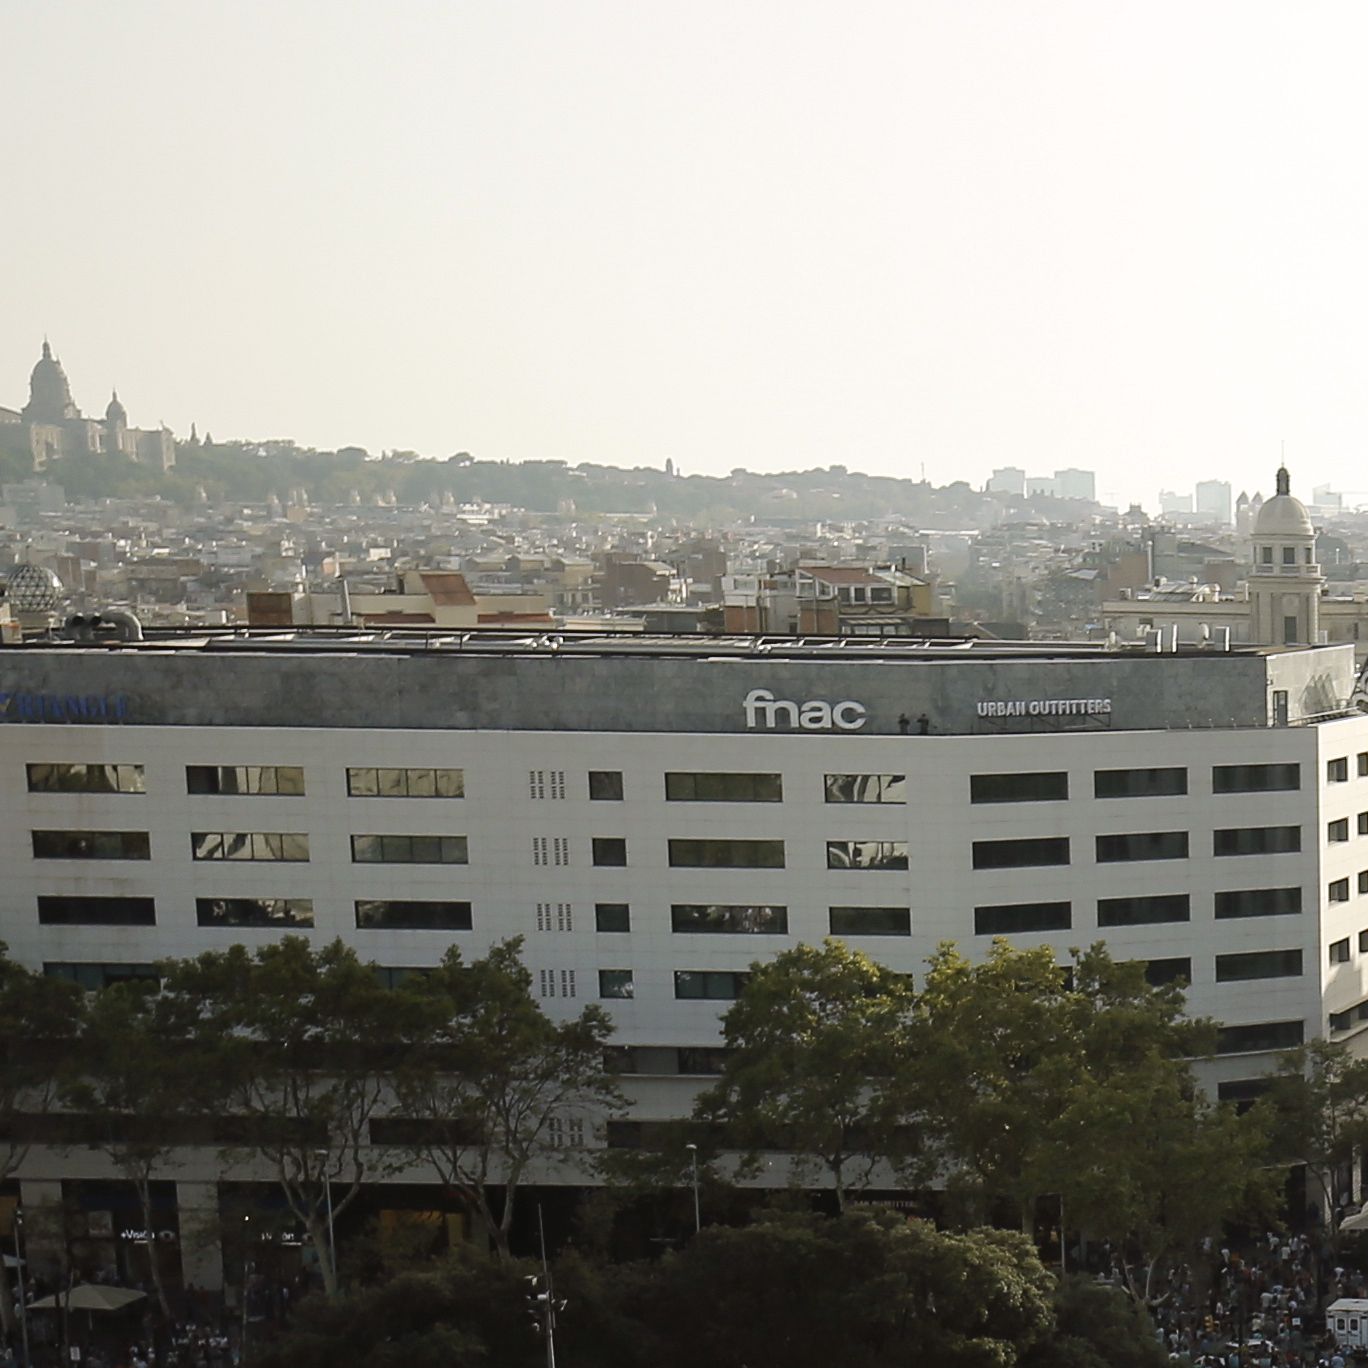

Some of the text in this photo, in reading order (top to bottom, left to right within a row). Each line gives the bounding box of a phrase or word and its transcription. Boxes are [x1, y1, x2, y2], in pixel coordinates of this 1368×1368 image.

[743, 688, 867, 731] fnac
[977, 698, 1112, 717] URBAN OUTFITTERS
